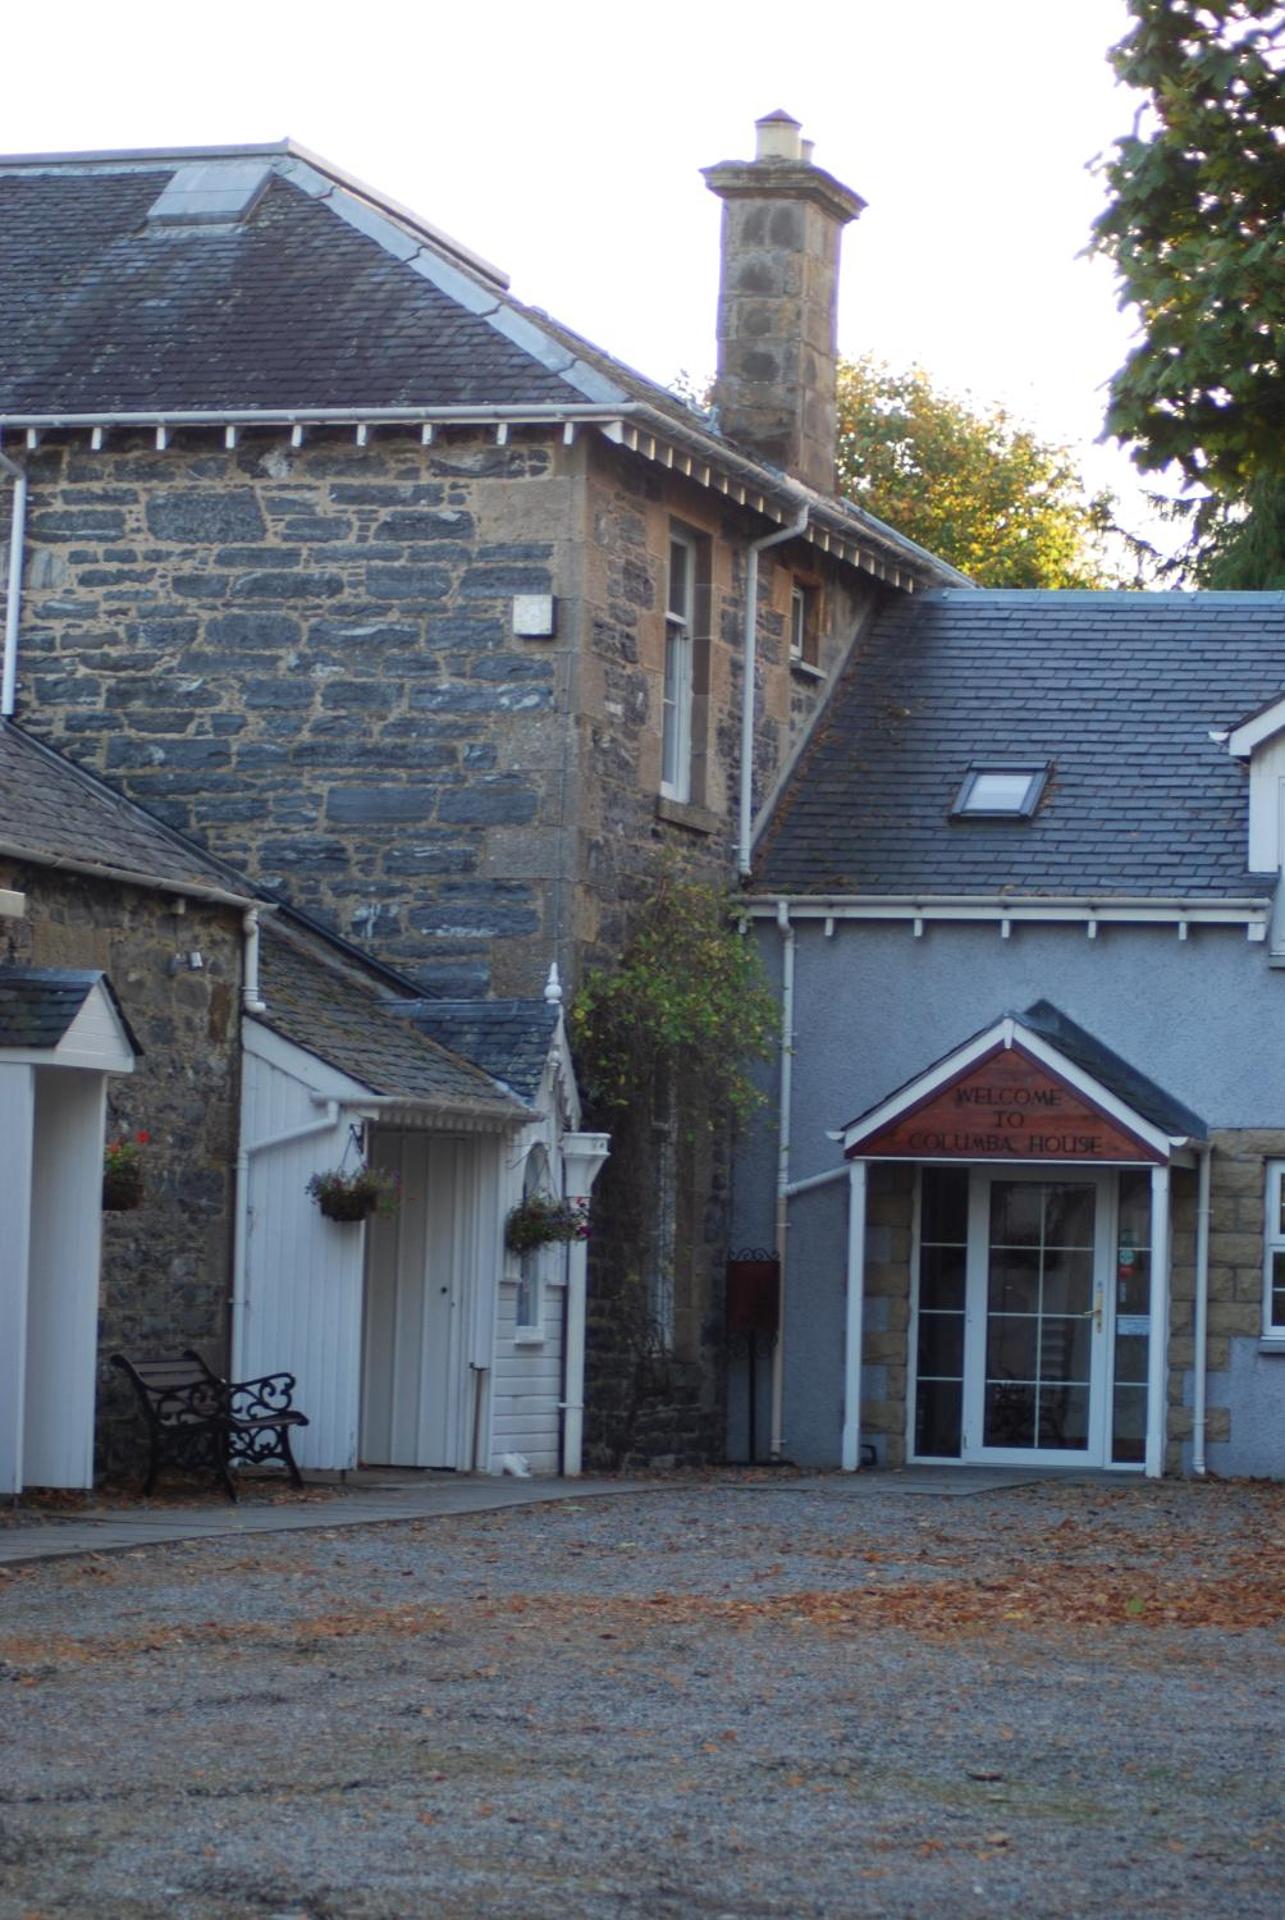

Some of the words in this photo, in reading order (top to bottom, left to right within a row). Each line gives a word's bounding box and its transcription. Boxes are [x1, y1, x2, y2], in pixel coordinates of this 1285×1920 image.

[955, 1087, 1061, 1107] WELCOME
[992, 1110, 1025, 1129] TO
[908, 1132, 1013, 1152] COLUMBA
[1028, 1135, 1103, 1154] HOUSE
